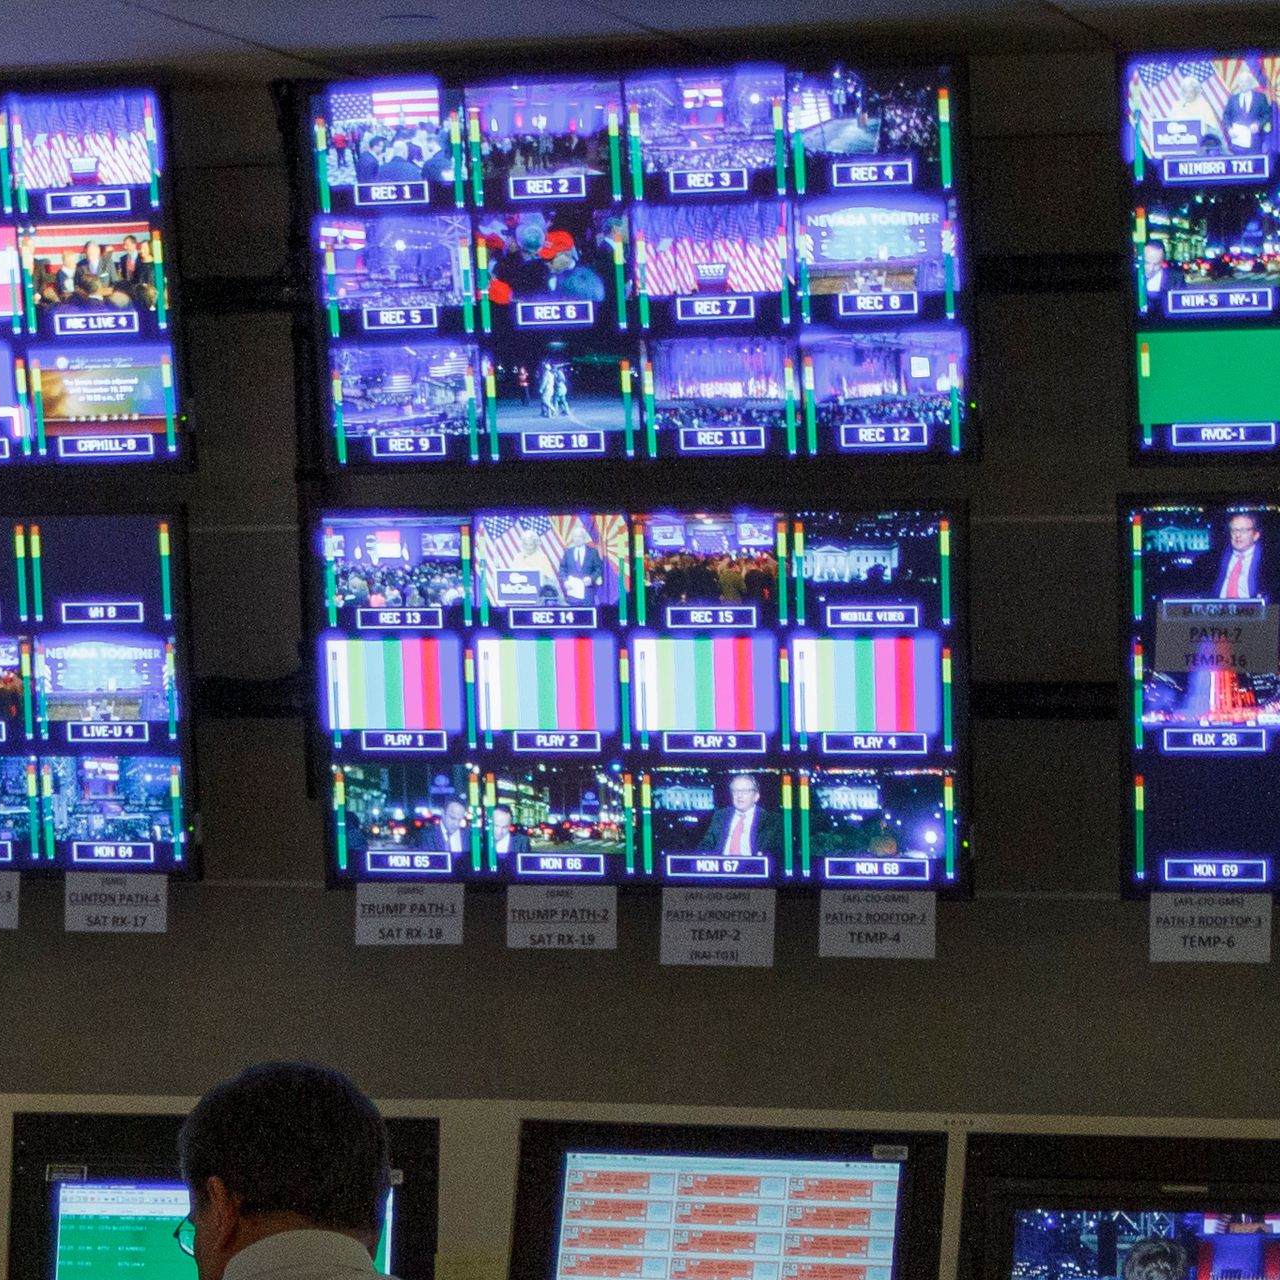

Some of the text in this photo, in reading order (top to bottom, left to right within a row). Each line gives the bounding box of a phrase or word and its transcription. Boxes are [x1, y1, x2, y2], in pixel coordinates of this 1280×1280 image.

[851, 166, 894, 181] REC 4
[1179, 159, 1253, 175] NIMBRA TX1
[526, 179, 568, 193] REC 2
[687, 172, 730, 187] REC 3
[371, 185, 411, 200] REC 1
[807, 212, 940, 227] NEVADA TOGETHER
[1181, 293, 1258, 307] NIM-5 NY-1
[534, 305, 576, 319] REC 6
[694, 300, 736, 314] REC 7
[380, 310, 421, 324] REC 5
[697, 431, 746, 445] REC 11
[858, 427, 910, 442] REC 12
[1201, 427, 1245, 440] AVOC-1
[388, 437, 430, 451] REC 9
[539, 434, 588, 448] REC 10
[379, 611, 421, 624] REC 13
[532, 611, 574, 624] REC 14
[690, 610, 733, 623] REC 15
[840, 611, 904, 622] MOBILE VIDEO
[45, 647, 161, 660] NEVADA TOGETHER
[1183, 654, 1247, 667] TEMP-16
[82, 725, 133, 737] LIVE-U 4
[384, 734, 424, 746] PLAY 1
[536, 734, 578, 747] PLAY 2
[693, 735, 737, 748] PLAY 3
[853, 736, 897, 749] PLAY 4
[1192, 733, 1238, 746] AUX 26
[94, 845, 133, 858] MON 64
[388, 855, 430, 868] MON 65
[540, 857, 582, 870] MON 66
[696, 860, 739, 872] MON 67
[855, 862, 899, 875] MON 68
[1193, 864, 1238, 877] MON 69
[691, 929, 741, 941] TEMP-2
[848, 932, 900, 943] TEMP-4
[1181, 935, 1235, 948] TEMP-6
